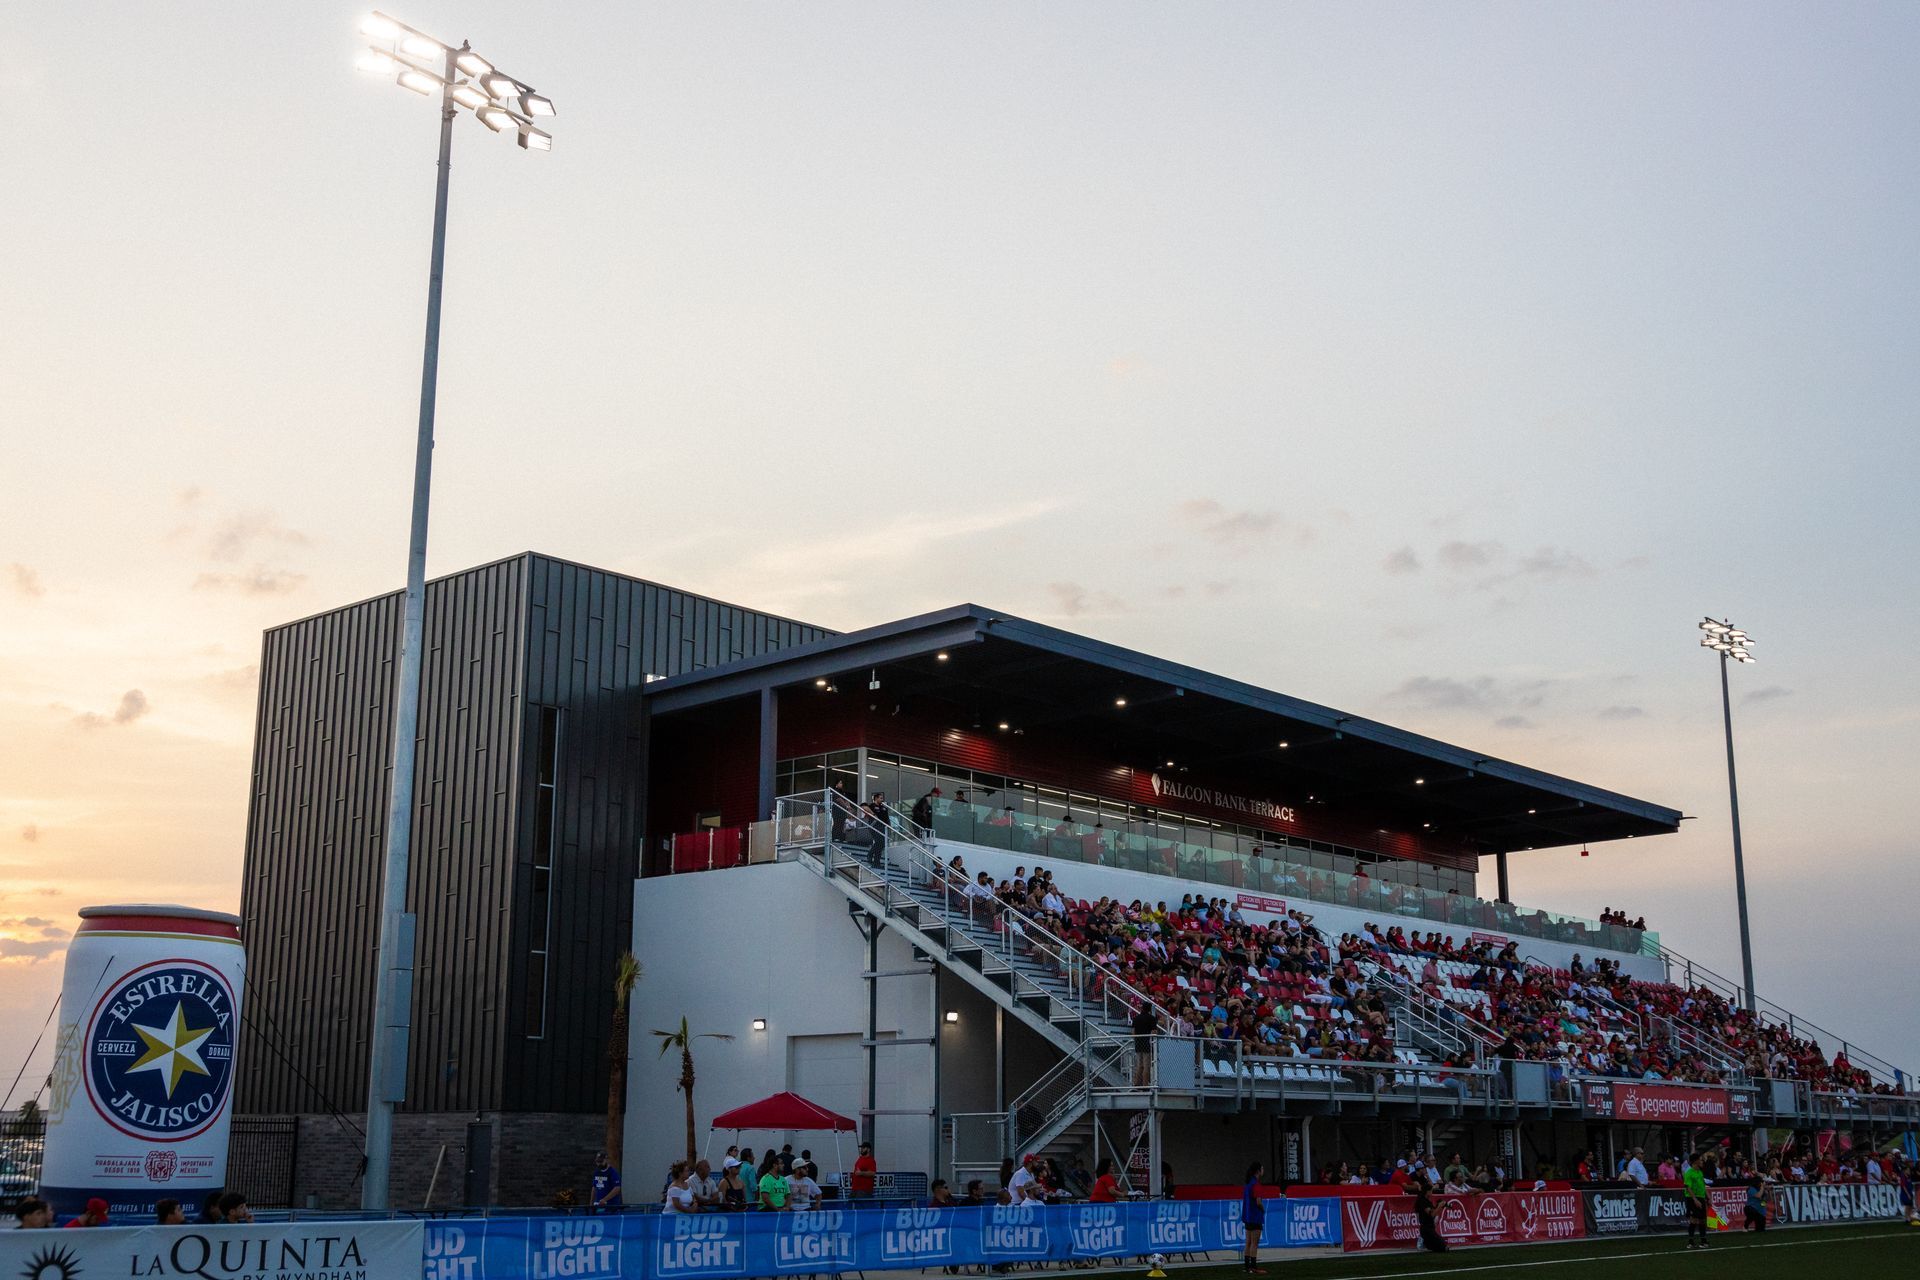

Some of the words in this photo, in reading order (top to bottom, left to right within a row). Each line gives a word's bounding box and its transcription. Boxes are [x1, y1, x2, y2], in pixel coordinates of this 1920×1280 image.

[1162, 779, 1212, 804] FALCON
[1214, 791, 1247, 812] BANK
[1250, 799, 1295, 822] TERRACE
[108, 974, 230, 1030] ESTRELLA
[97, 1042, 136, 1053] CERVEZA
[208, 1046, 230, 1057] DORADA
[110, 1090, 214, 1128] JALISCO
[1640, 1097, 1690, 1119] pegenergy
[1691, 1097, 1725, 1115] stadium
[1288, 1132, 1299, 1181] Sames
[878, 1176, 894, 1187] BAR
[110, 1204, 138, 1213] CERVEZA
[1539, 1196, 1575, 1216] ALLOGIC
[1593, 1193, 1636, 1218] Sames
[1663, 1197, 1688, 1217] stew
[1711, 1191, 1748, 1204] GALLEGO
[1785, 1184, 1850, 1222] VAMOS
[895, 1208, 942, 1229] BUD
[992, 1206, 1034, 1225] BUD
[1079, 1206, 1117, 1228] BUD
[1156, 1203, 1191, 1222] BUD
[1293, 1204, 1319, 1222] BUD
[1383, 1210, 1421, 1228] Vaswa
[1446, 1209, 1462, 1219] TACO
[1483, 1208, 1498, 1217] TACO
[1726, 1204, 1746, 1215] PAVI
[674, 1215, 729, 1241] BUD
[791, 1210, 844, 1234] BUD
[1150, 1222, 1197, 1244] LIGHT
[1290, 1221, 1326, 1240] LIGHT
[1443, 1219, 1468, 1232] PALENQUE
[1479, 1218, 1503, 1231] PALENQUE
[1547, 1221, 1575, 1238] GROUP
[424, 1226, 466, 1257] UD
[544, 1219, 605, 1249] BUD
[886, 1228, 947, 1254] LIGHT
[985, 1225, 1043, 1248] LIGHT
[1073, 1225, 1125, 1251] LIGHT
[1392, 1228, 1421, 1240] GROUP
[130, 1254, 165, 1276] LA
[170, 1234, 364, 1280] QUINTA
[663, 1241, 740, 1269] LIGHT
[780, 1232, 852, 1261] LIGHT
[423, 1256, 477, 1280] GHT
[533, 1244, 615, 1280] LIGHT
